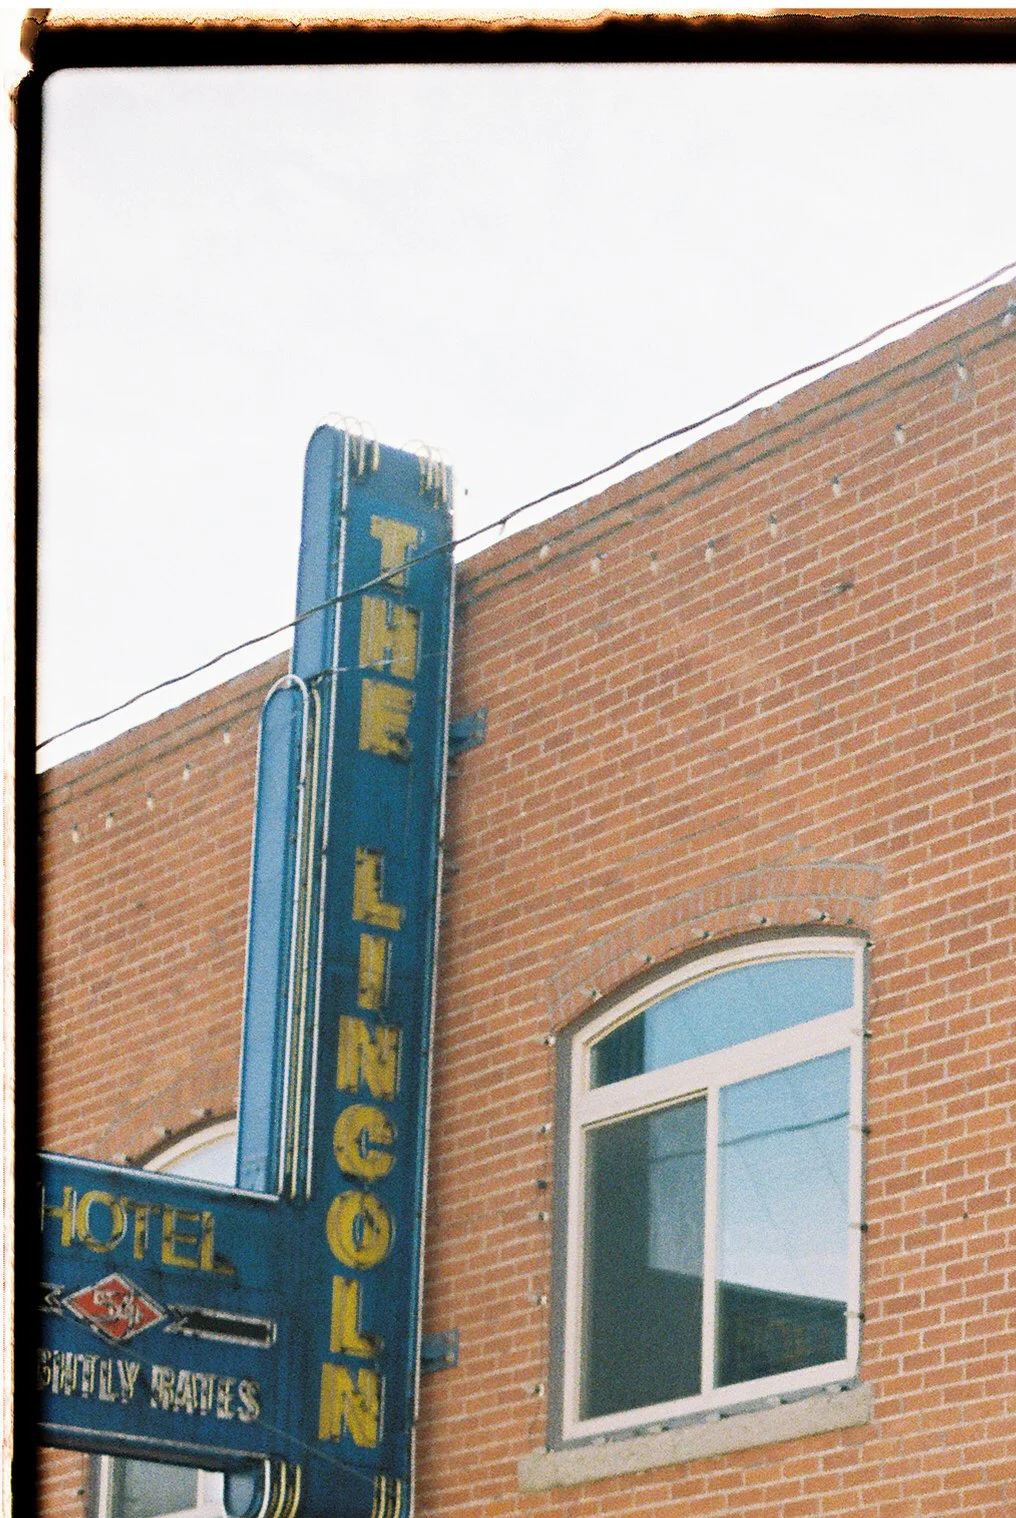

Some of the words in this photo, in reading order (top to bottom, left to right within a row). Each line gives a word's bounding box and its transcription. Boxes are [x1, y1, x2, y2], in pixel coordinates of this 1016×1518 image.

[358, 514, 422, 758] THE
[41, 1186, 236, 1275] HOTEL
[319, 848, 404, 1449] LINCOLN
[151, 1364, 261, 1423] RATES
